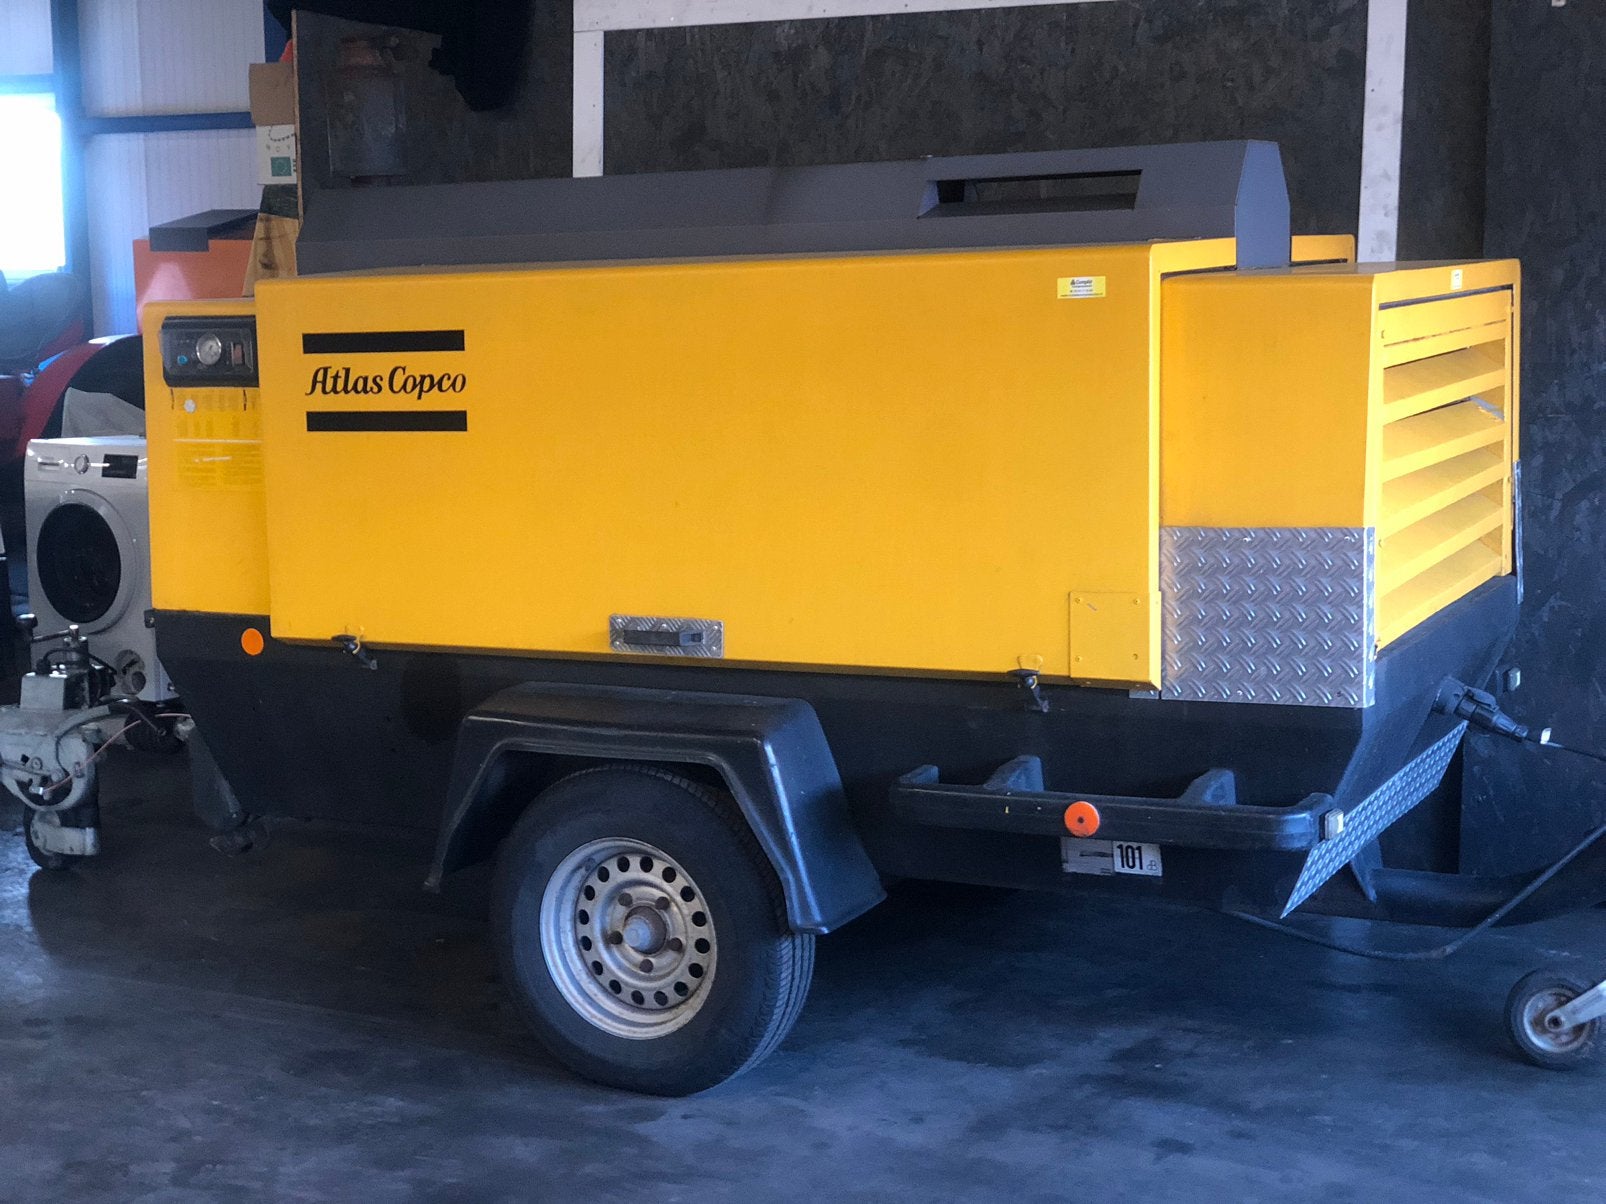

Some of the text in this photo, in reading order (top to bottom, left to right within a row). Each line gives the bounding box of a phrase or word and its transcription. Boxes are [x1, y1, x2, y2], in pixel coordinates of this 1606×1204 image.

[305, 365, 467, 401] Atlas Copco
[1117, 843, 1143, 870] 101
